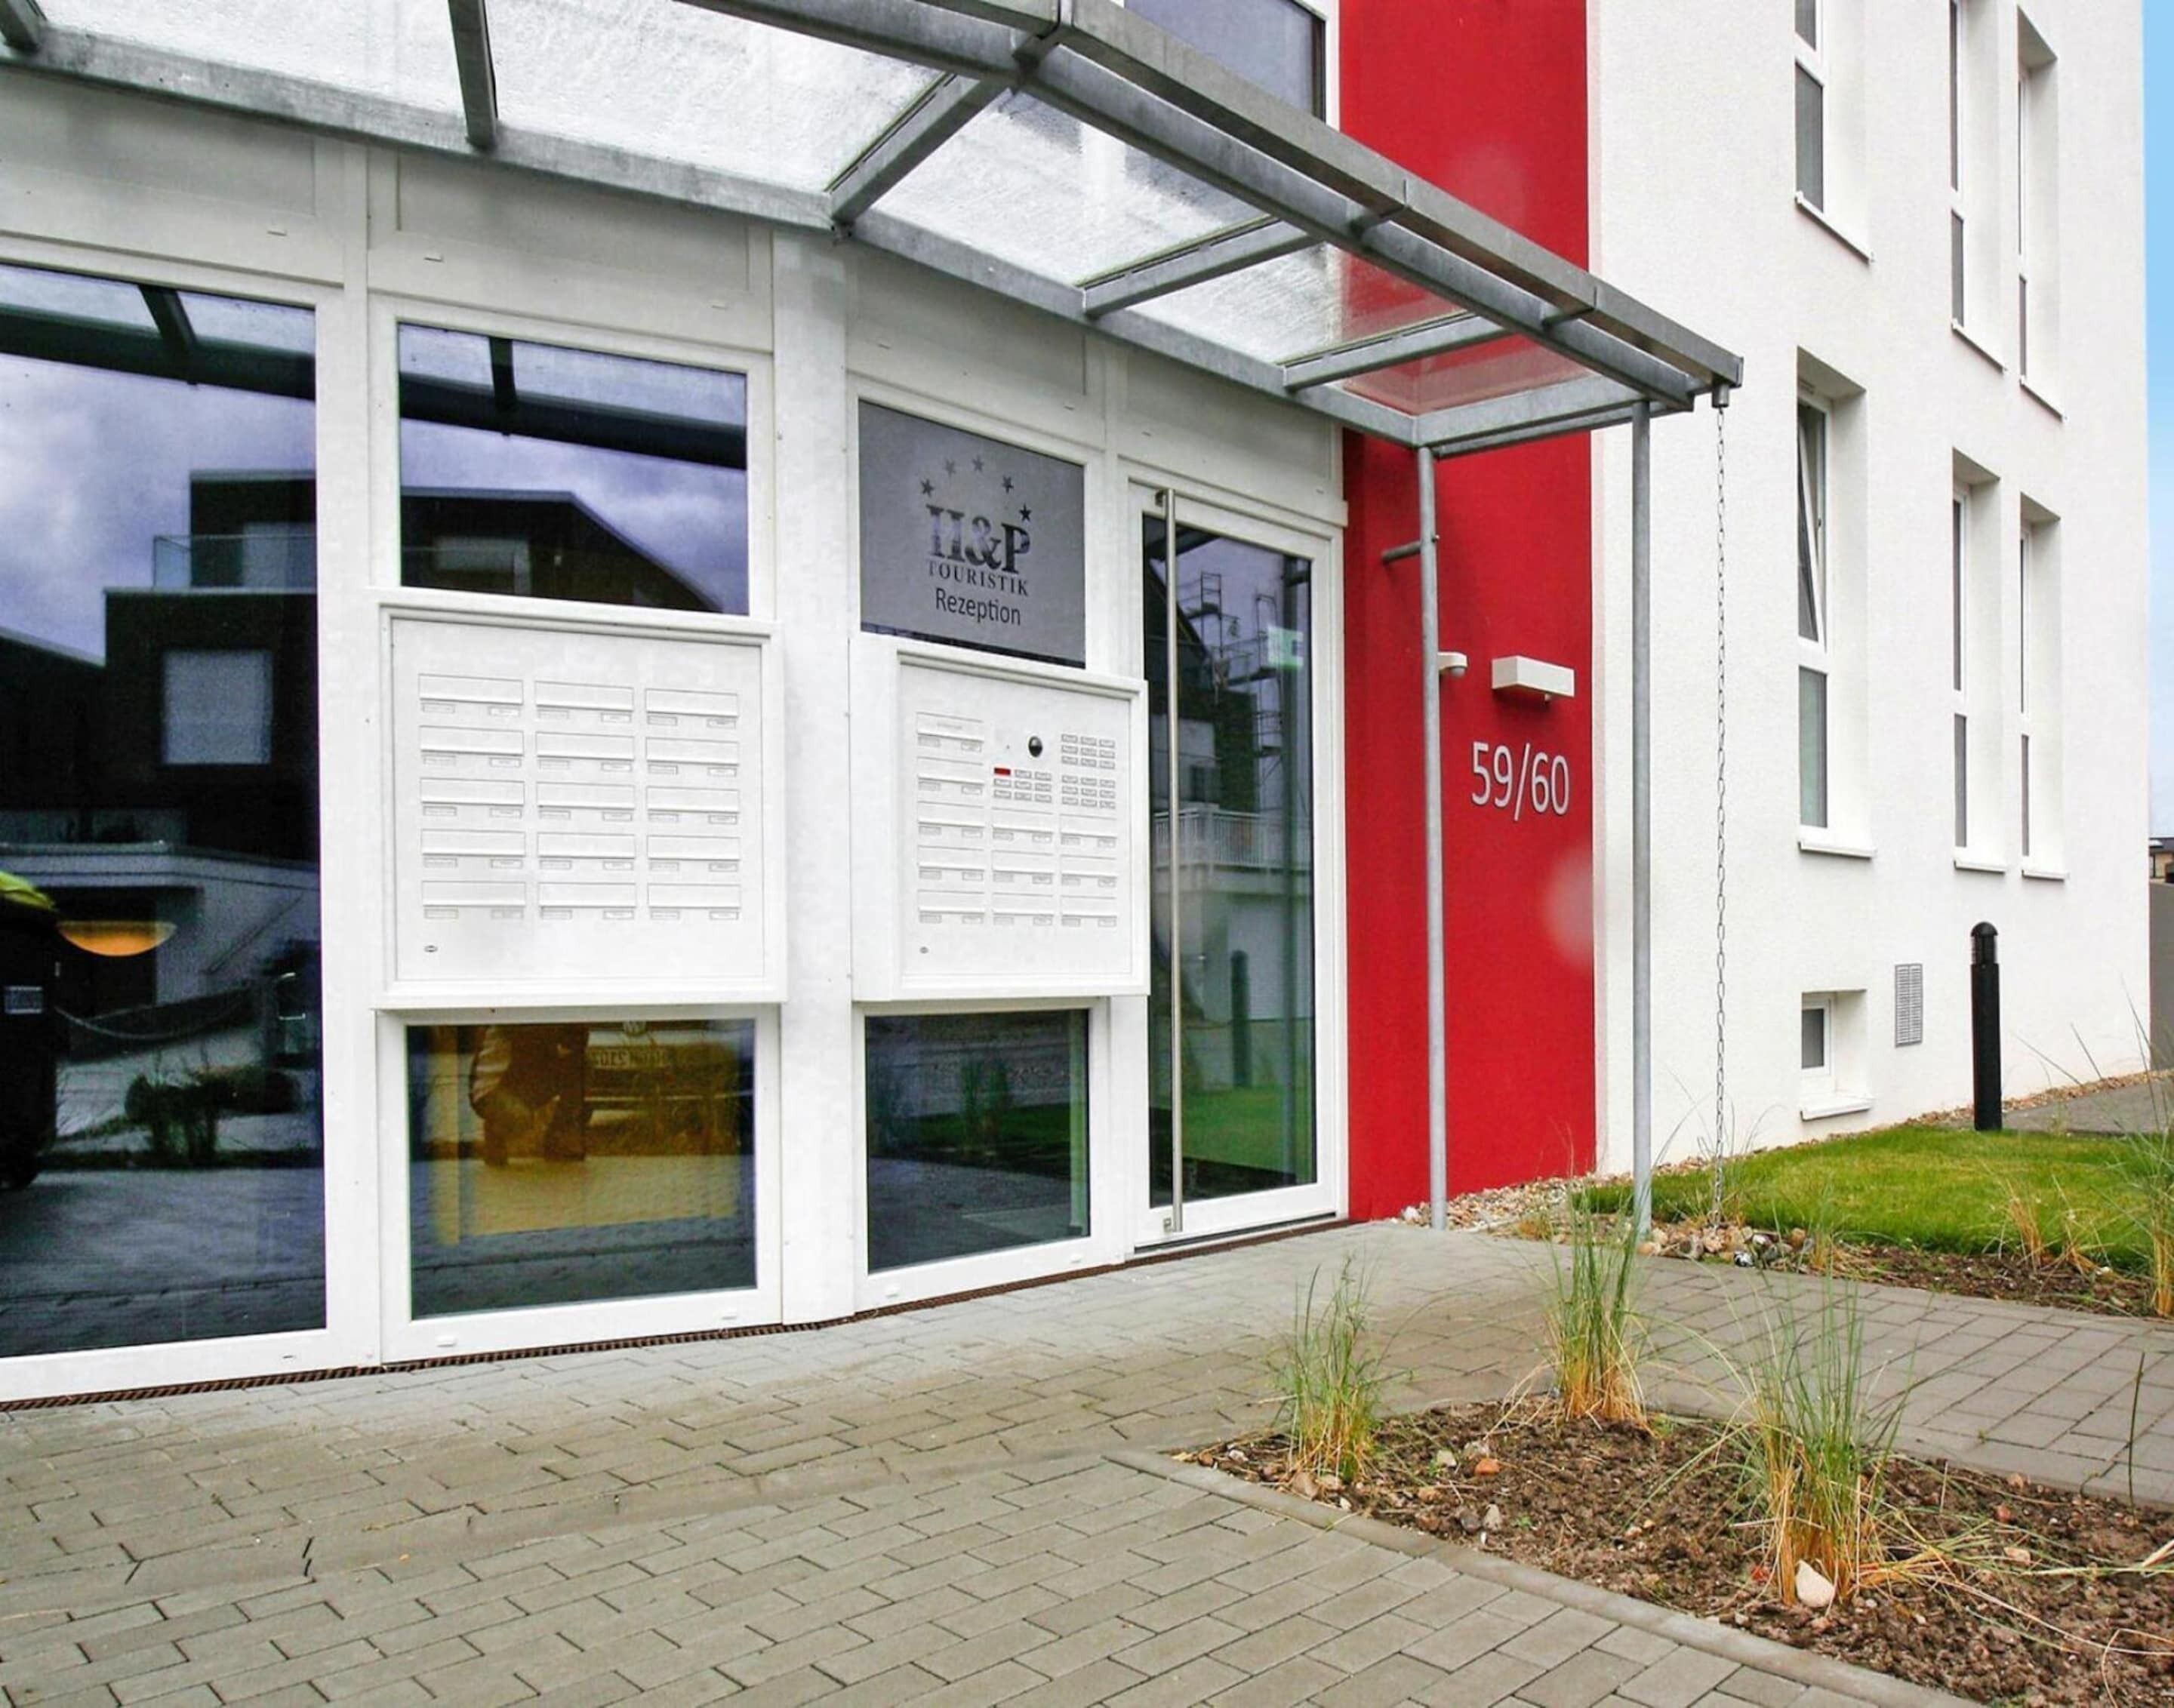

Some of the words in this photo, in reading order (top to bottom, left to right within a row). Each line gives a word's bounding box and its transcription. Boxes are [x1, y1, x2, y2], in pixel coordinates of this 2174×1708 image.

[926, 504, 1030, 575] H&P
[928, 561, 1030, 597] TOURISTIK
[935, 587, 1021, 626] Rezeption
[1471, 740, 1570, 822] 59/60
